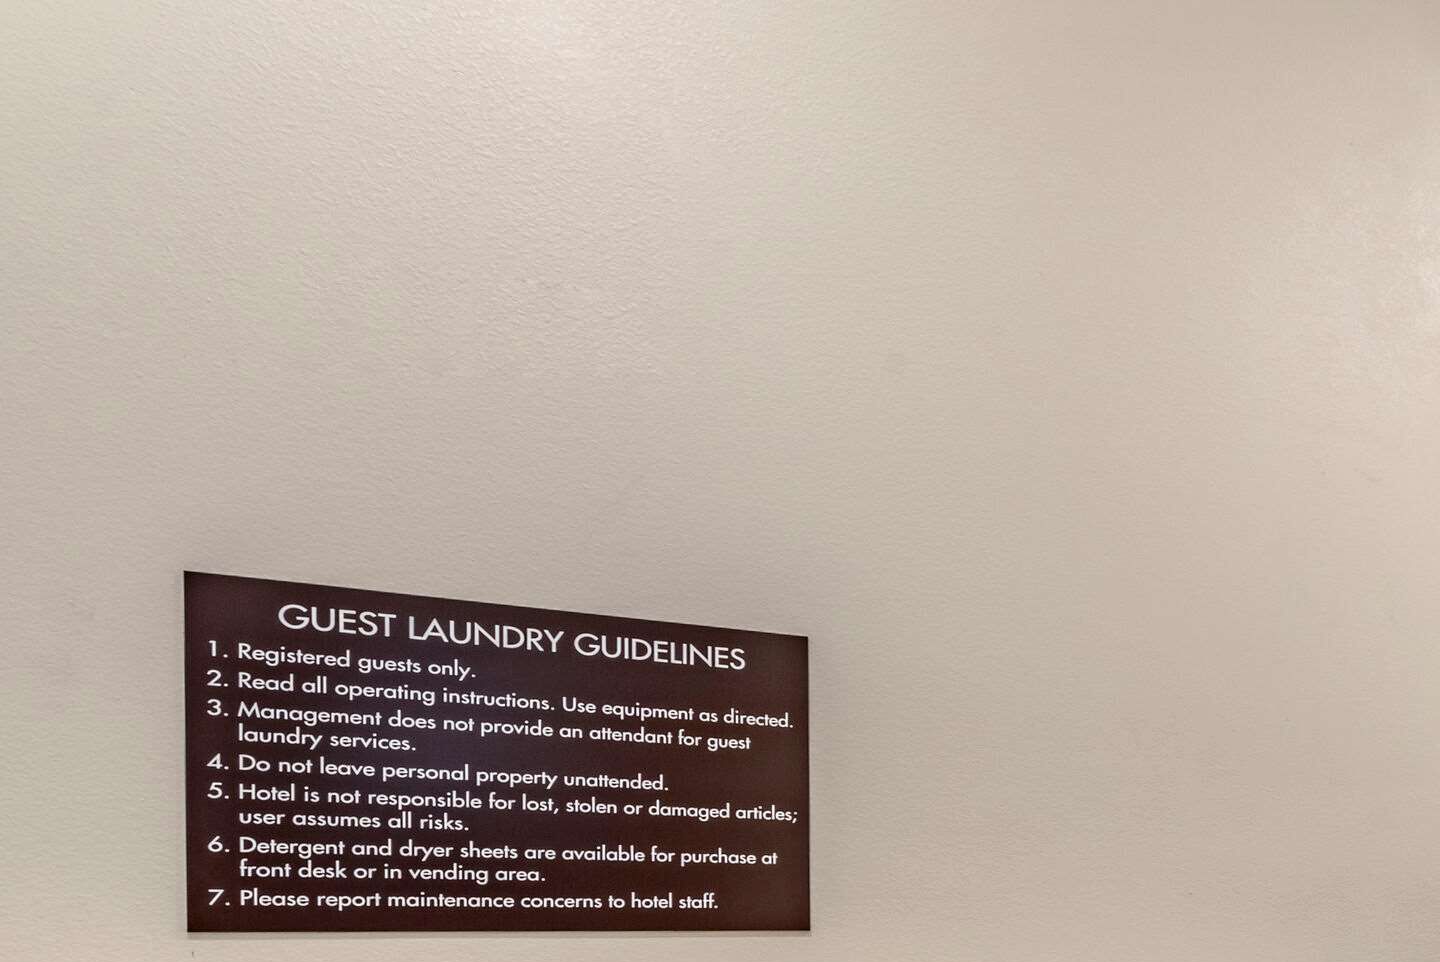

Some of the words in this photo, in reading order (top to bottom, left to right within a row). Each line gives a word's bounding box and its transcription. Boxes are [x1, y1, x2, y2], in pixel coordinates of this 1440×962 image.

[277, 603, 397, 638] GUEST
[408, 615, 565, 653] LAUNDRY
[573, 632, 746, 671] GUIDELINES
[208, 639, 229, 658] 1.
[238, 642, 351, 668] Registered
[357, 657, 422, 674] guests
[427, 658, 476, 682] only.
[206, 669, 229, 688] 2.
[238, 671, 295, 692] Read
[301, 675, 328, 694] all
[334, 684, 436, 707] operating
[442, 687, 555, 711] instructions.
[562, 696, 597, 714] Use
[601, 701, 695, 722] equipment
[698, 711, 719, 723] as
[723, 707, 794, 729] directed.
[206, 698, 229, 717] 3.
[237, 700, 383, 727] Management
[387, 709, 437, 730] does
[443, 718, 475, 732] not
[480, 718, 554, 738] provide
[558, 727, 583, 739] an
[588, 726, 674, 745] attendant
[677, 728, 703, 747] for
[706, 736, 752, 752] guest
[238, 722, 323, 751] laundry
[329, 732, 417, 752] services.
[206, 752, 230, 770] 4.
[238, 753, 271, 772] Do
[278, 759, 314, 774] not
[319, 755, 376, 777] leave
[382, 763, 469, 783] personal
[476, 771, 559, 790] property
[563, 772, 669, 791] unattended.
[207, 781, 230, 800] 5.
[238, 782, 296, 802] Hotel
[303, 785, 320, 803] is
[327, 789, 362, 804] not
[367, 790, 483, 811] responsible
[488, 791, 517, 810] for
[522, 792, 559, 815] lost,
[565, 796, 618, 814] stolen
[623, 804, 644, 815] or
[648, 799, 731, 822] damaged
[735, 804, 798, 824] articles;
[238, 812, 286, 825] user
[292, 814, 382, 828] assumes
[387, 810, 412, 829] all
[419, 812, 469, 831] risks.
[207, 835, 230, 853] 6.
[239, 836, 346, 860] Detergent
[351, 838, 393, 857] and
[399, 838, 454, 862] dryer
[459, 840, 519, 860] sheets
[524, 848, 557, 860] are
[561, 843, 646, 862] available
[650, 844, 676, 863] for
[680, 847, 757, 868] purchase
[760, 852, 779, 865] at
[239, 857, 292, 878] front
[297, 859, 348, 879] desk
[353, 867, 377, 879] or
[383, 863, 402, 880] in
[408, 862, 489, 886] vending
[494, 870, 546, 882] area.
[207, 888, 231, 906] 7.
[239, 887, 310, 907] Please
[317, 892, 382, 912] report
[387, 891, 515, 908] maintenance
[520, 897, 603, 909] concerns
[607, 895, 626, 909] to
[630, 891, 673, 909] hotel
[678, 892, 719, 909] staff.
